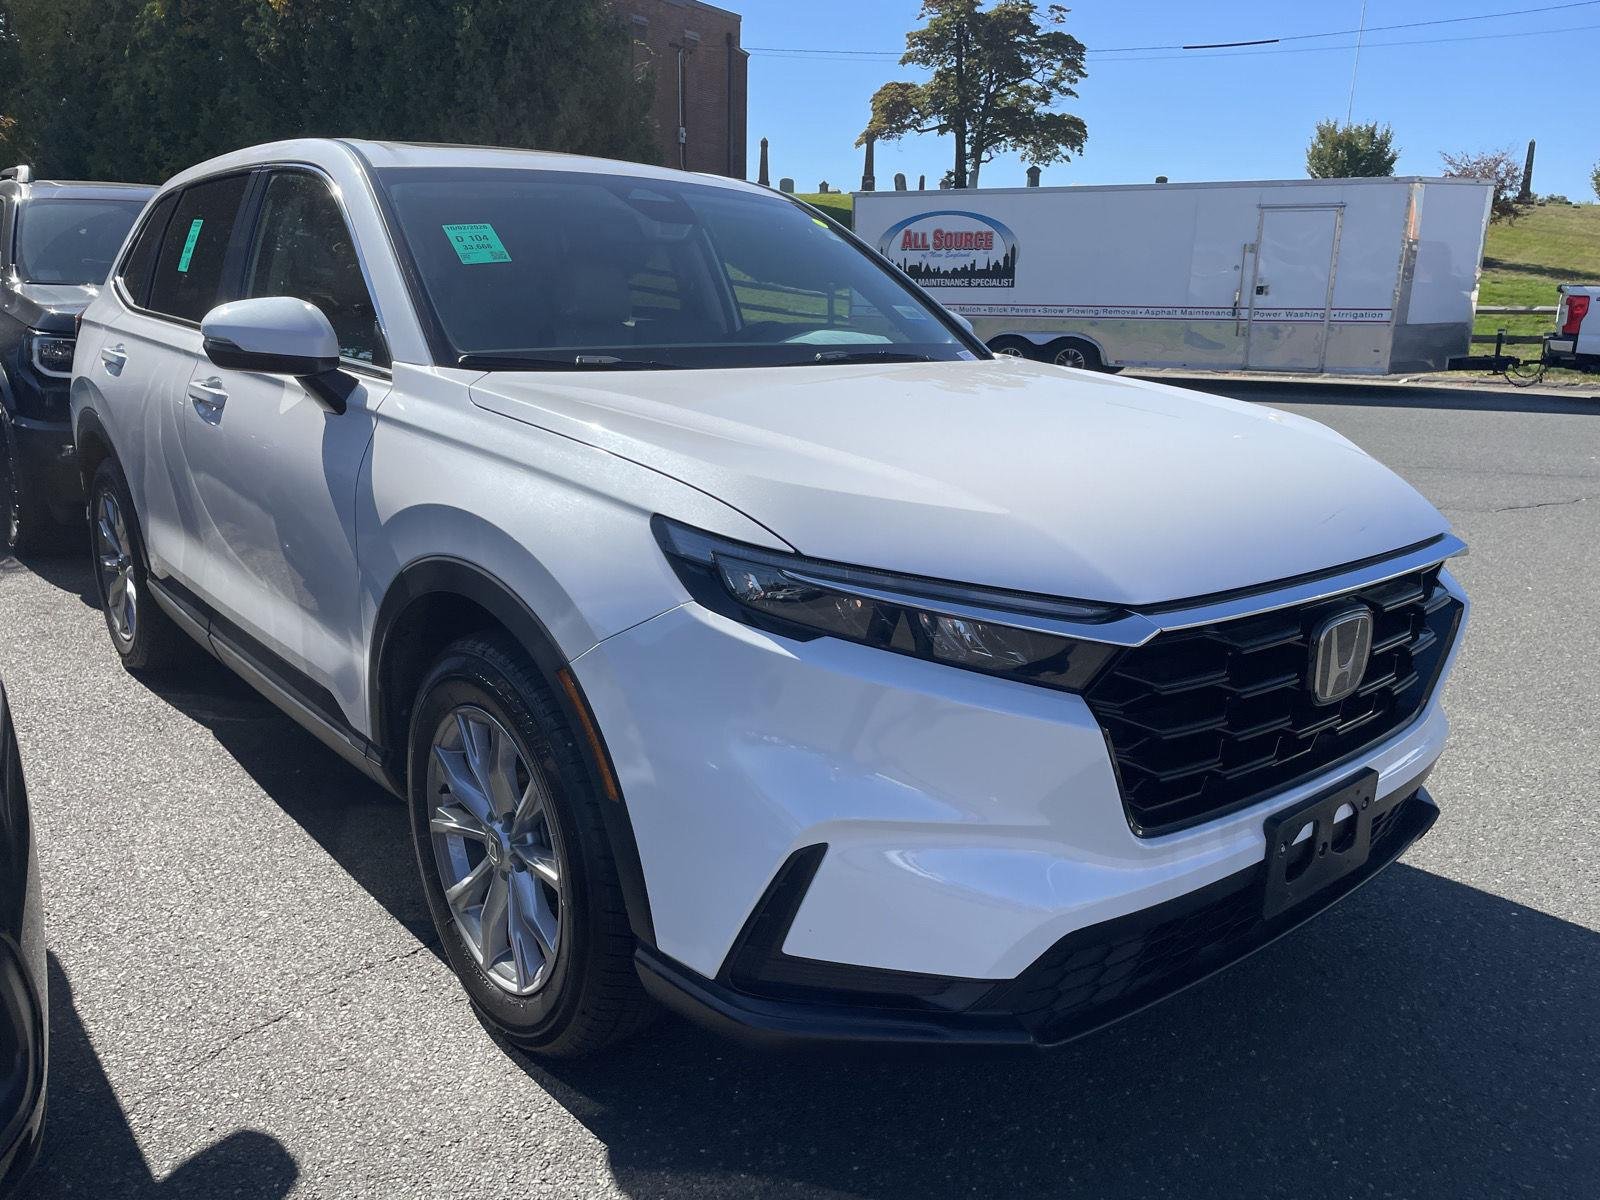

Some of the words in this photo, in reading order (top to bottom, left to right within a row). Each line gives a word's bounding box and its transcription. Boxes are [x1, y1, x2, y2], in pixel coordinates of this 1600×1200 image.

[469, 234, 489, 242] 104
[917, 278, 969, 287] MAINTENANCE
[970, 278, 1013, 287] SPECIALIST
[1144, 308, 1177, 317] Asphalt
[1180, 309, 1235, 317] Maintenanc
[1253, 310, 1282, 318] Power
[1285, 311, 1325, 319] Washing
[1337, 311, 1384, 319] Irrigation
